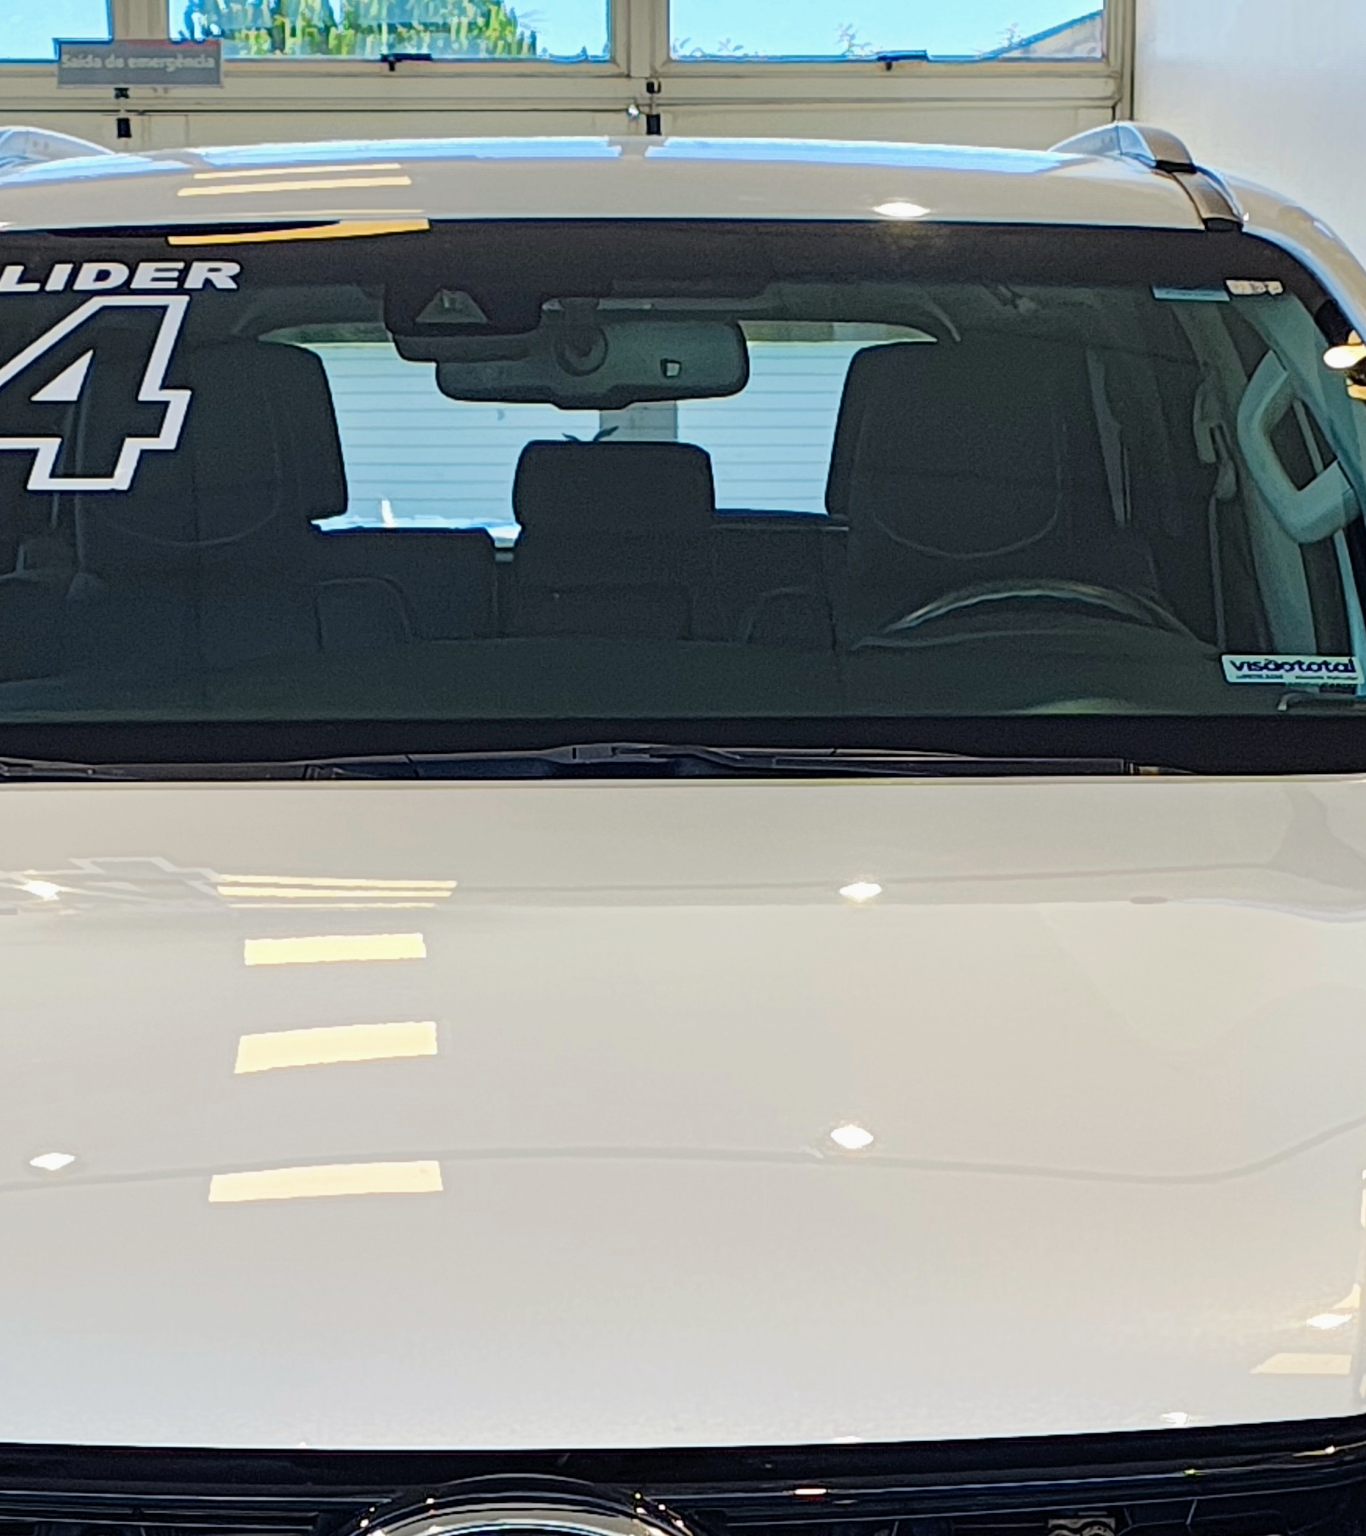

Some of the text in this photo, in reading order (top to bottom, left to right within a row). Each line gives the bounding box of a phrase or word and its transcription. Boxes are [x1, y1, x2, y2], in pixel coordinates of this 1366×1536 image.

[62, 53, 215, 73] Saída de emergência
